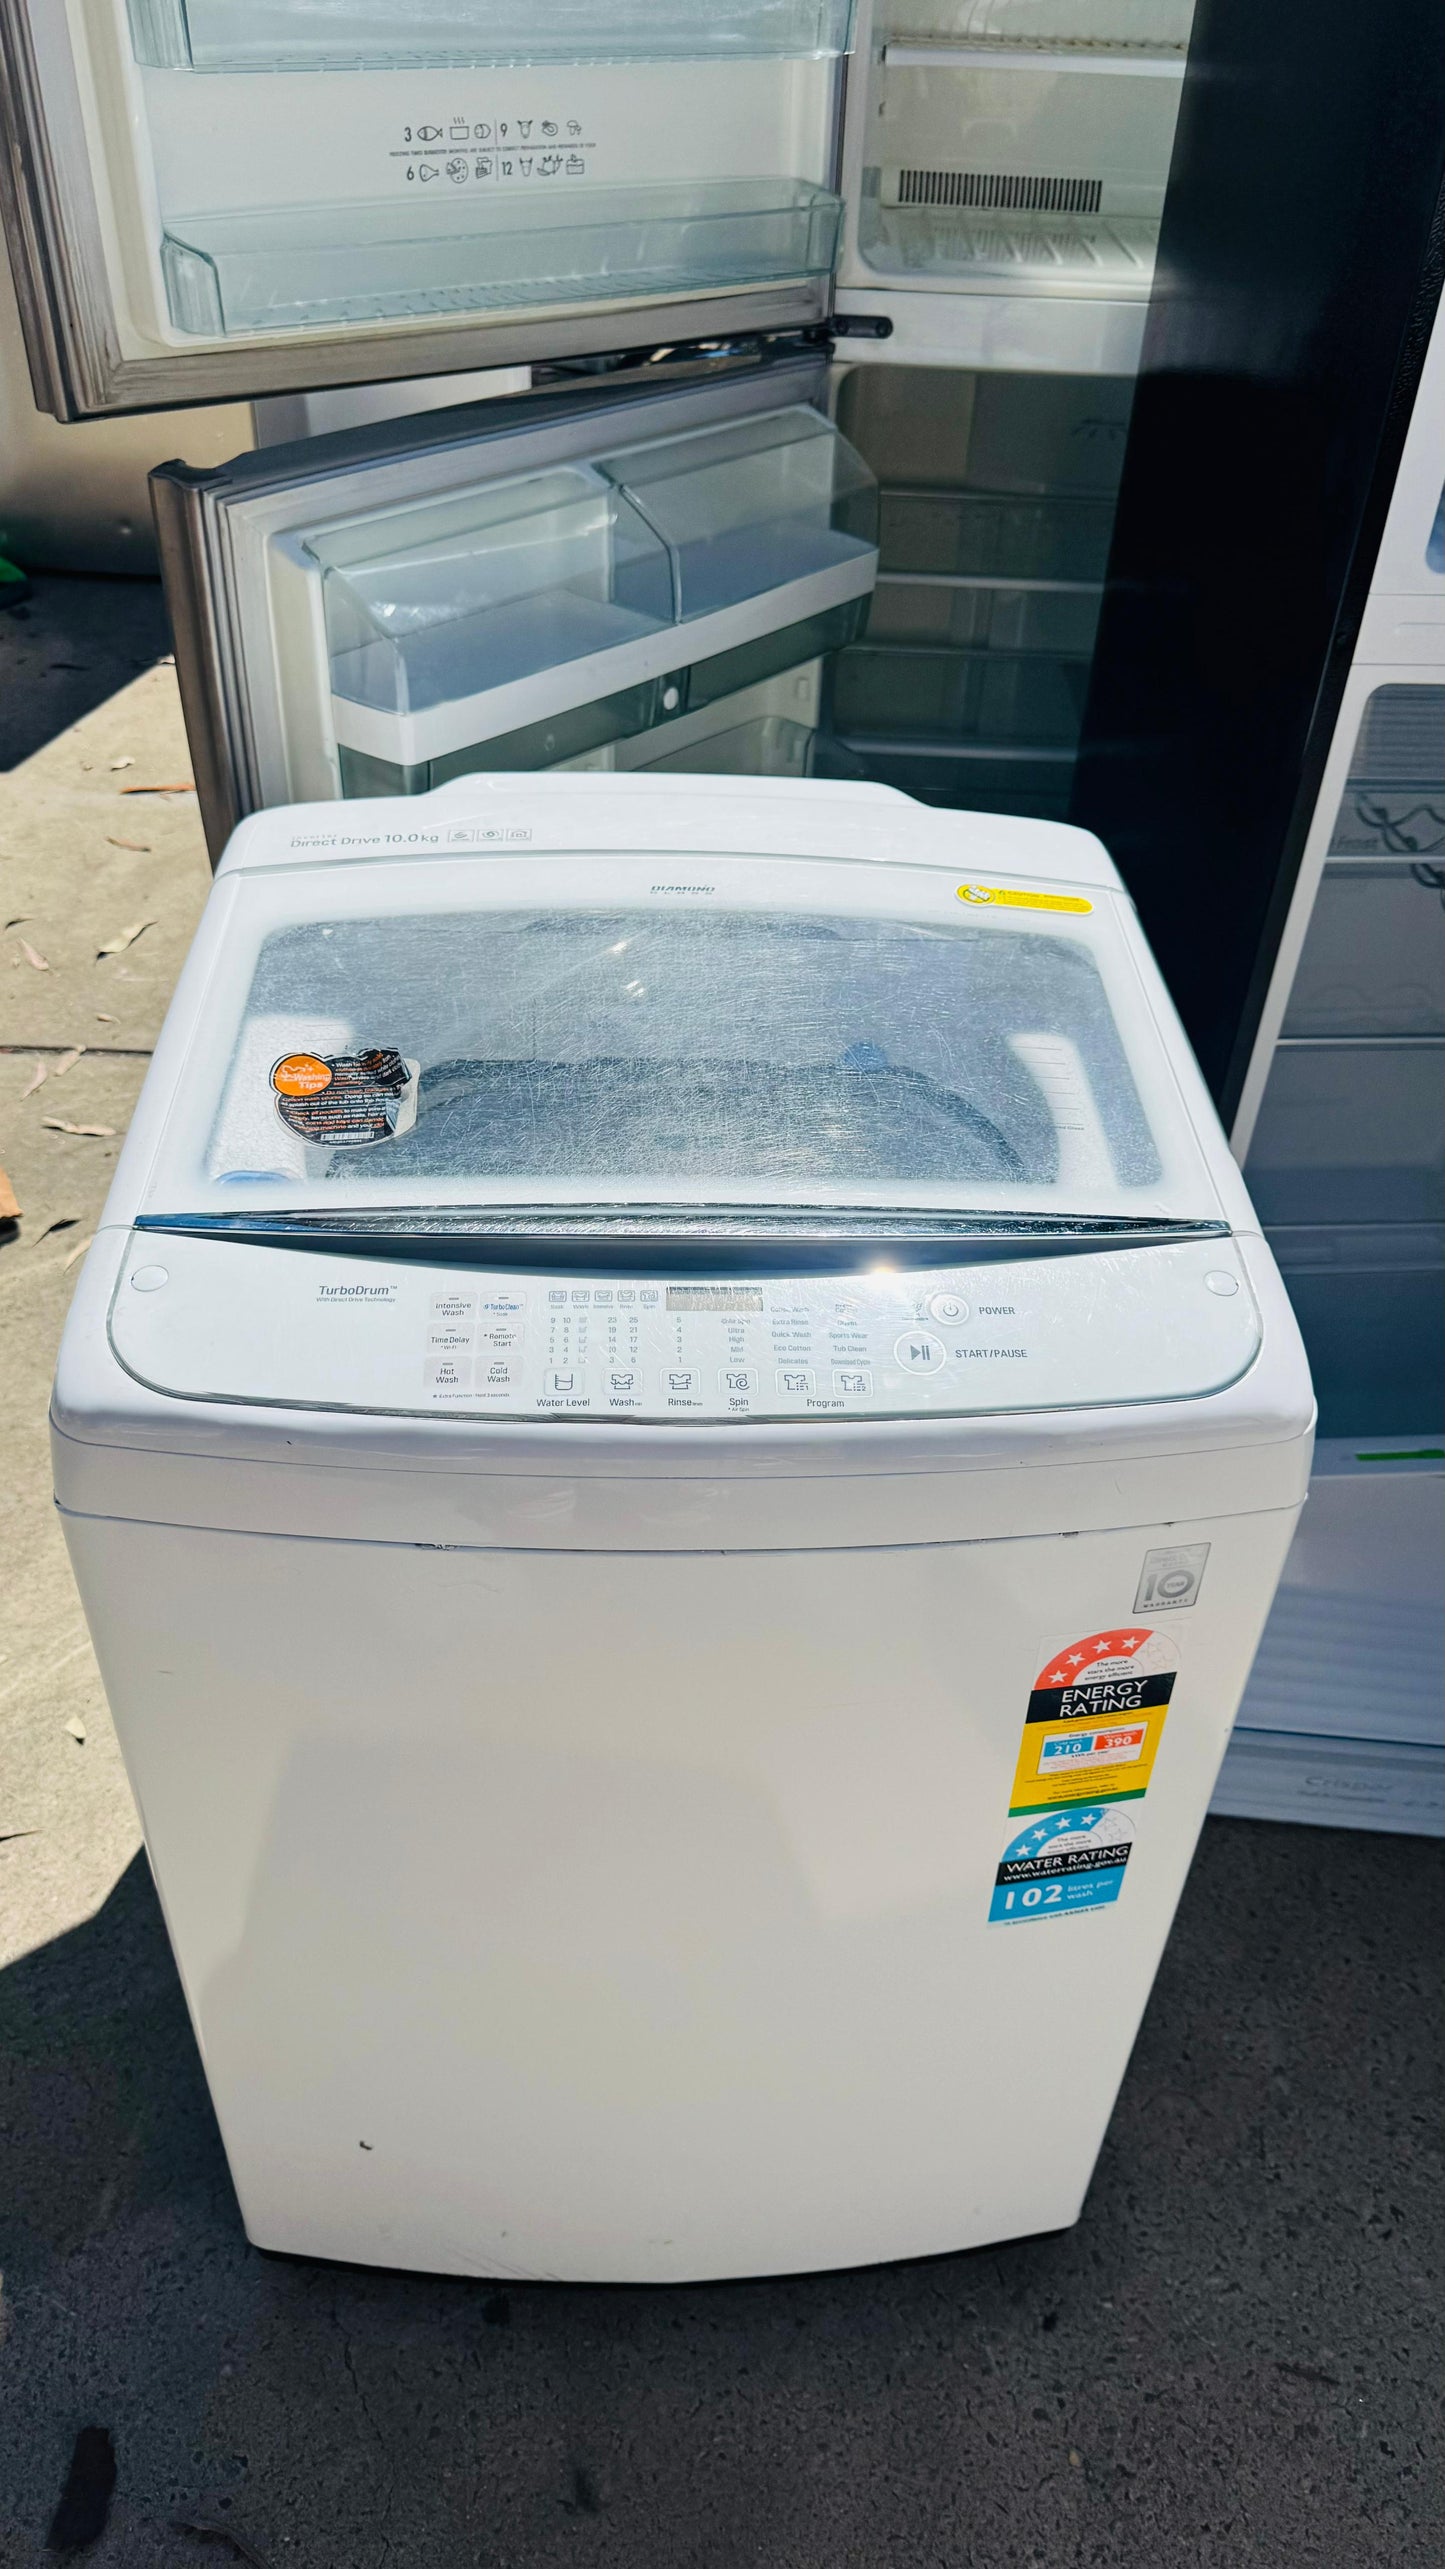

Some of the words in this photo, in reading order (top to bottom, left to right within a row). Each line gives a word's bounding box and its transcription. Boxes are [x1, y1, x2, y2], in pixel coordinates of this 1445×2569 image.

[404, 126, 411, 142] 3
[500, 123, 507, 137] 9
[406, 166, 414, 181] 6
[502, 161, 513, 176] 12
[290, 838, 337, 848] Direct
[341, 836, 381, 845] Drive
[384, 833, 418, 843] 10.0
[421, 834, 440, 843] kg
[299, 1081, 323, 1090] Tips
[435, 1302, 472, 1310] Intensive
[979, 1306, 1016, 1315] POWER
[431, 1336, 449, 1344] Time
[449, 1336, 470, 1344] Delay
[728, 1336, 745, 1344] High
[773, 1344, 787, 1352] Eco
[788, 1344, 812, 1352] Cotton
[955, 1349, 1028, 1359] START/PAUSE
[778, 1357, 809, 1365] Delicates
[489, 1367, 508, 1375] Cold
[435, 1376, 459, 1384] Wash
[487, 1375, 511, 1383] Wash
[536, 1398, 564, 1407] Water
[566, 1398, 591, 1407] Level
[609, 1398, 635, 1407] Wash
[667, 1397, 692, 1407] Rinse
[729, 1397, 749, 1407] Spin
[806, 1398, 845, 1409] Program
[1144, 1569, 1195, 1601] 10
[1084, 1674, 1106, 1682] energy
[1062, 1680, 1148, 1703] ENERGY
[1060, 1695, 1142, 1717] RATING
[1104, 1735, 1132, 1749] 390
[1054, 1743, 1082, 1755] 210
[1006, 1857, 1064, 1873] WATER
[1067, 1846, 1129, 1863] RATING
[1004, 1857, 1127, 1881] www.waterrating.gov.au
[1005, 1884, 1063, 1910] 102
[1067, 1889, 1094, 1900] wash
